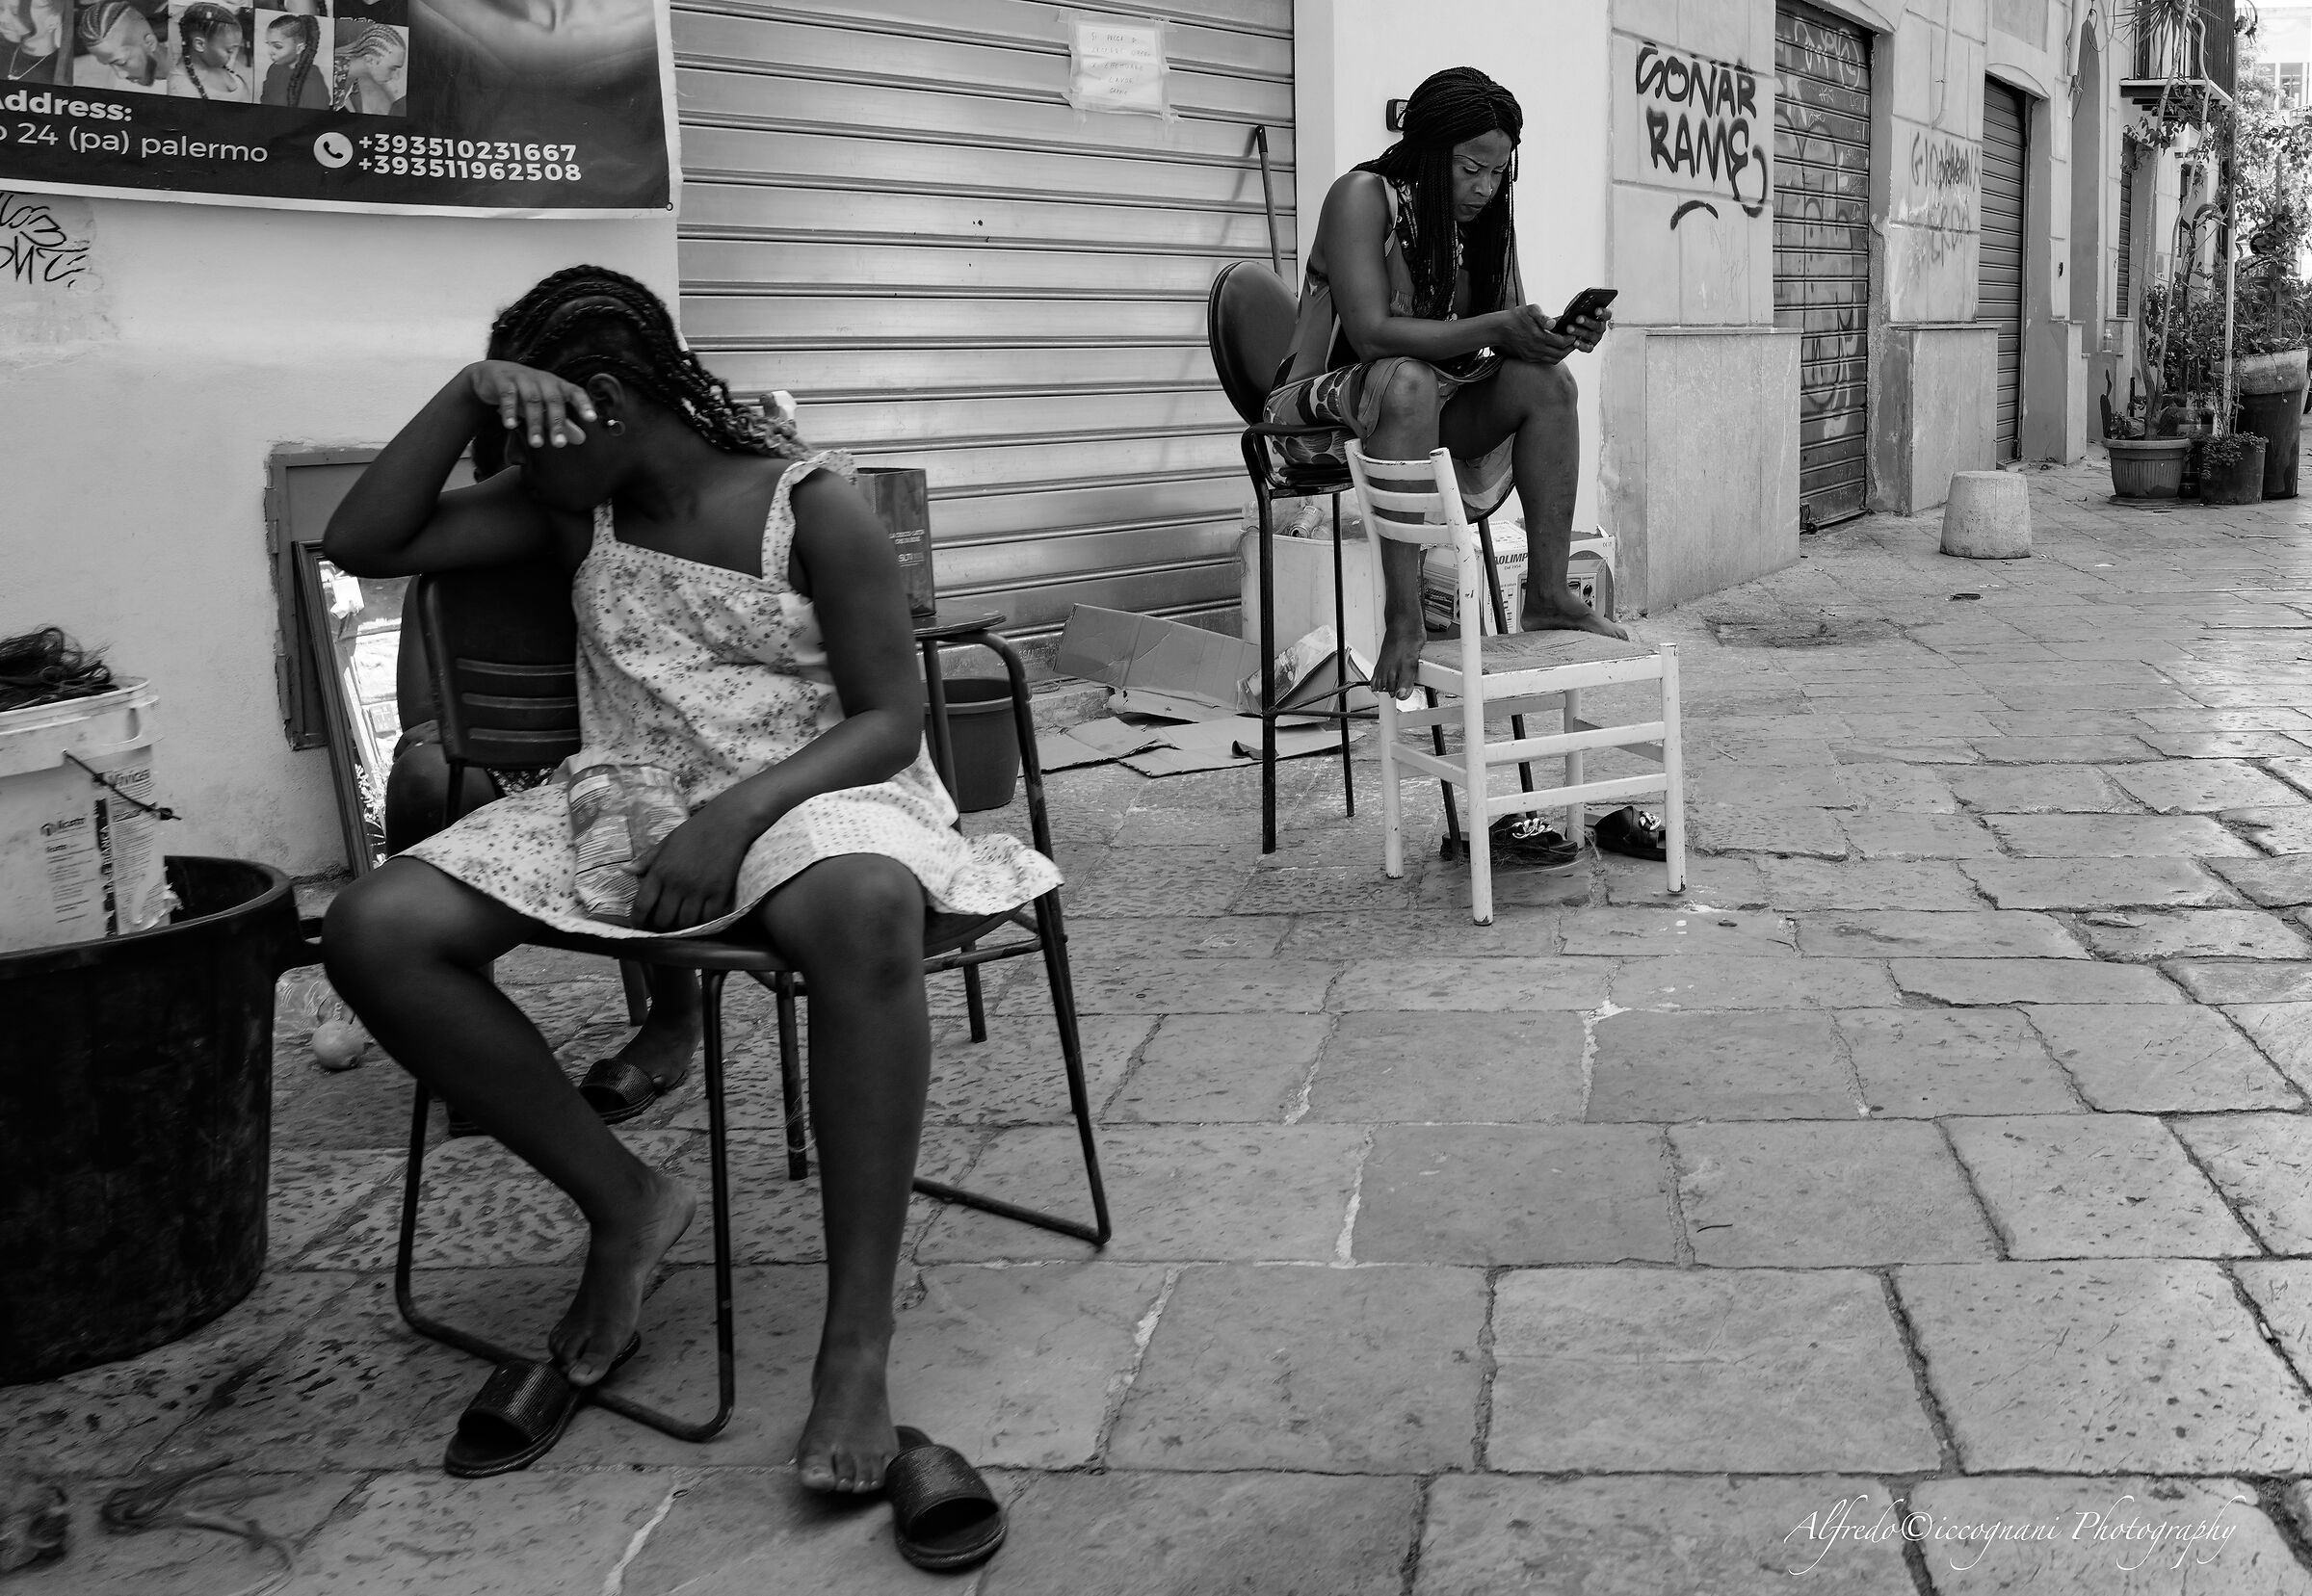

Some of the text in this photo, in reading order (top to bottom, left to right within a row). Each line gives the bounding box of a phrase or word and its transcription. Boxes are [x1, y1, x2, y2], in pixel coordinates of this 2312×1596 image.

[17, 122, 59, 145] 24
[69, 125, 130, 155] (pa)
[142, 136, 268, 163] palermo
[359, 133, 576, 162] +393510231667
[358, 155, 582, 181] +393511962508
